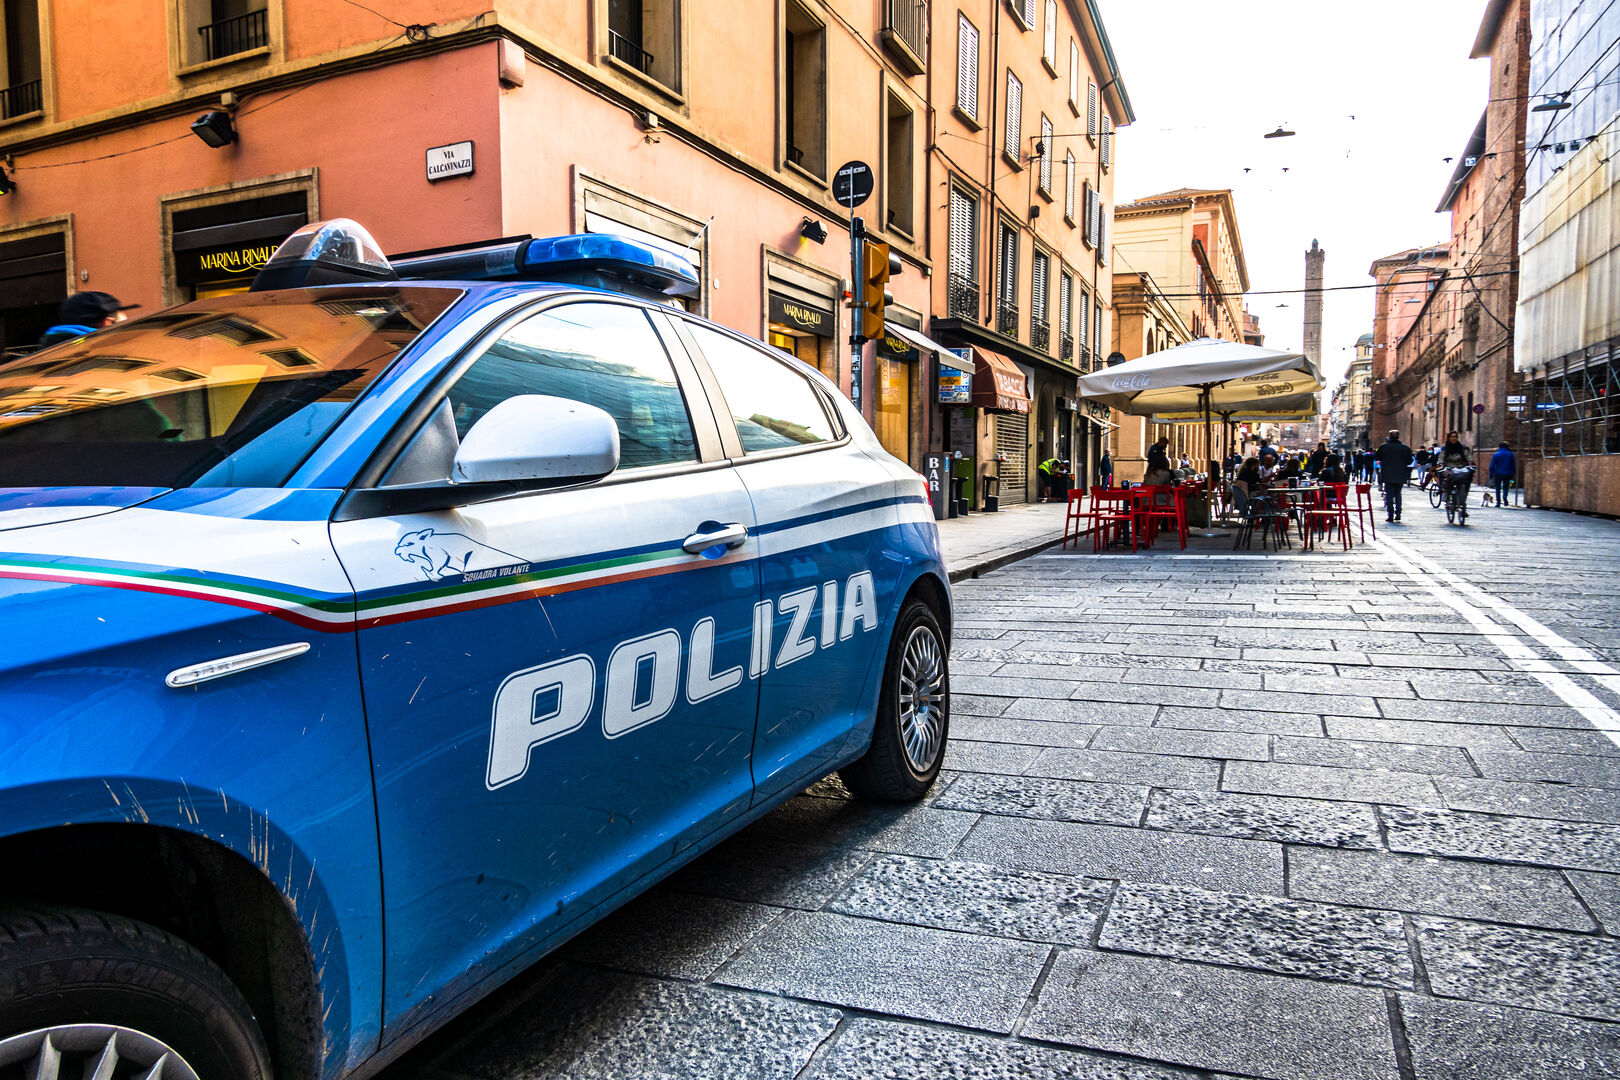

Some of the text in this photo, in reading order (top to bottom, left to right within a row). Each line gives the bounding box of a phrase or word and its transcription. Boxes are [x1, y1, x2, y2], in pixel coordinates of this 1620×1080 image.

[443, 150, 455, 159] VIA
[428, 158, 471, 175] CALCAVINAZZI
[200, 245, 280, 272] MARINA RINALD
[928, 457, 940, 492] BAR
[462, 563, 531, 583] SQUADRA VOLANTE
[485, 569, 879, 791] POLIZIA
